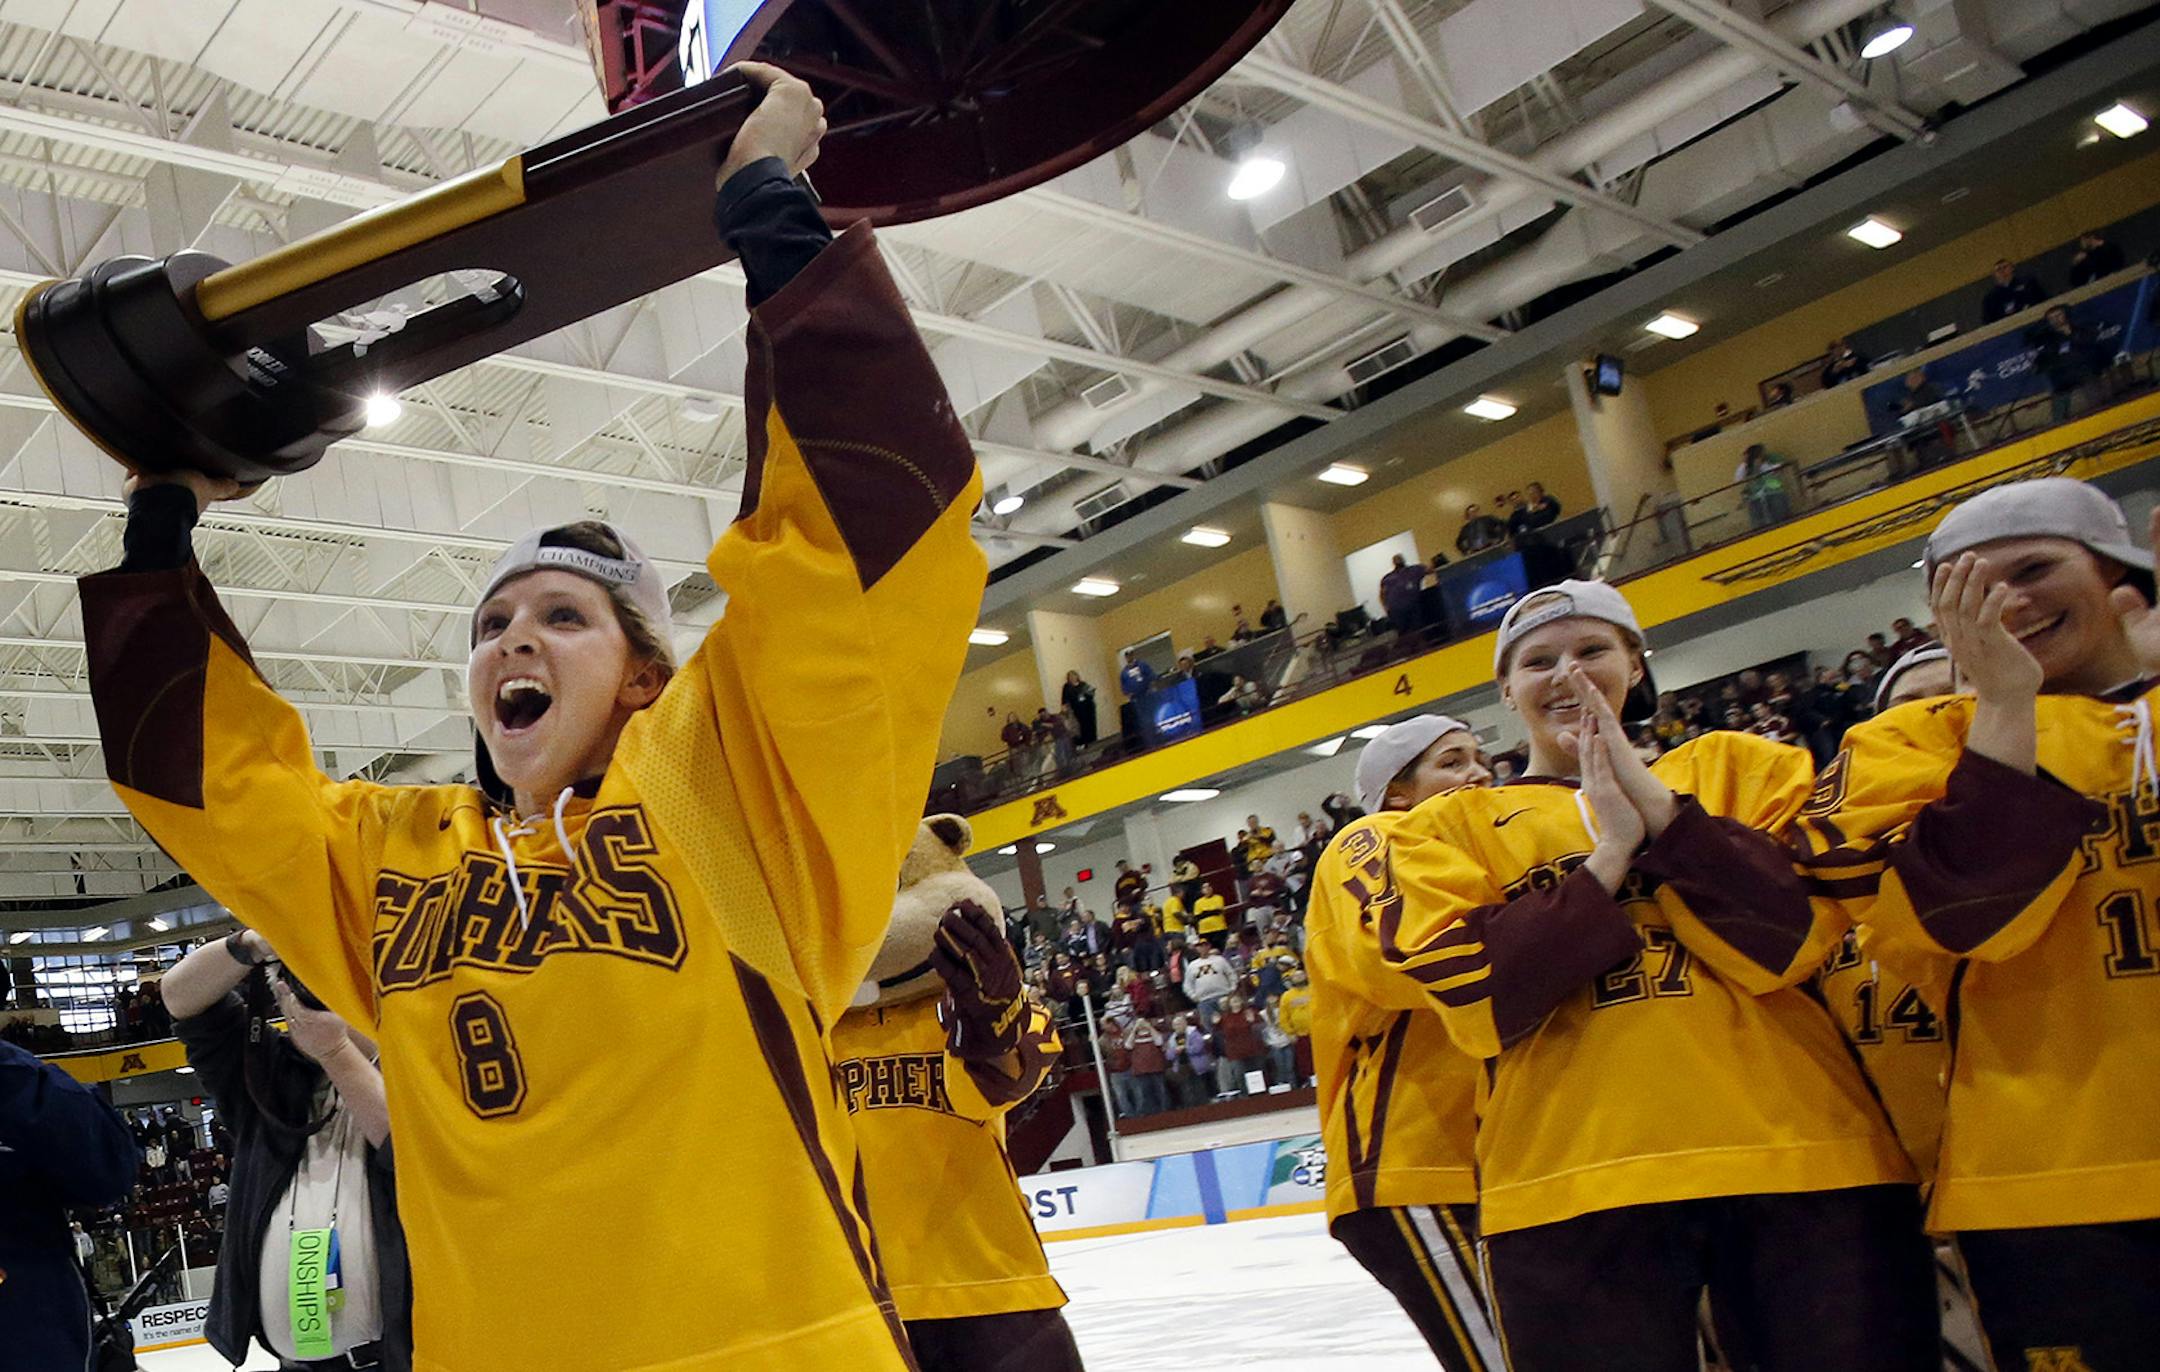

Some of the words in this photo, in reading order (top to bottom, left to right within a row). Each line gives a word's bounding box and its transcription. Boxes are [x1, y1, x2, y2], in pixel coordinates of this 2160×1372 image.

[541, 551, 635, 581] CHAMPIONS
[1393, 673, 1413, 697] 4
[2096, 887, 2160, 981] 1
[1852, 979, 1943, 1044] 14
[448, 989, 528, 1120] 8
[1021, 1186, 1079, 1219] ST
[141, 1305, 209, 1328] RESPEC
